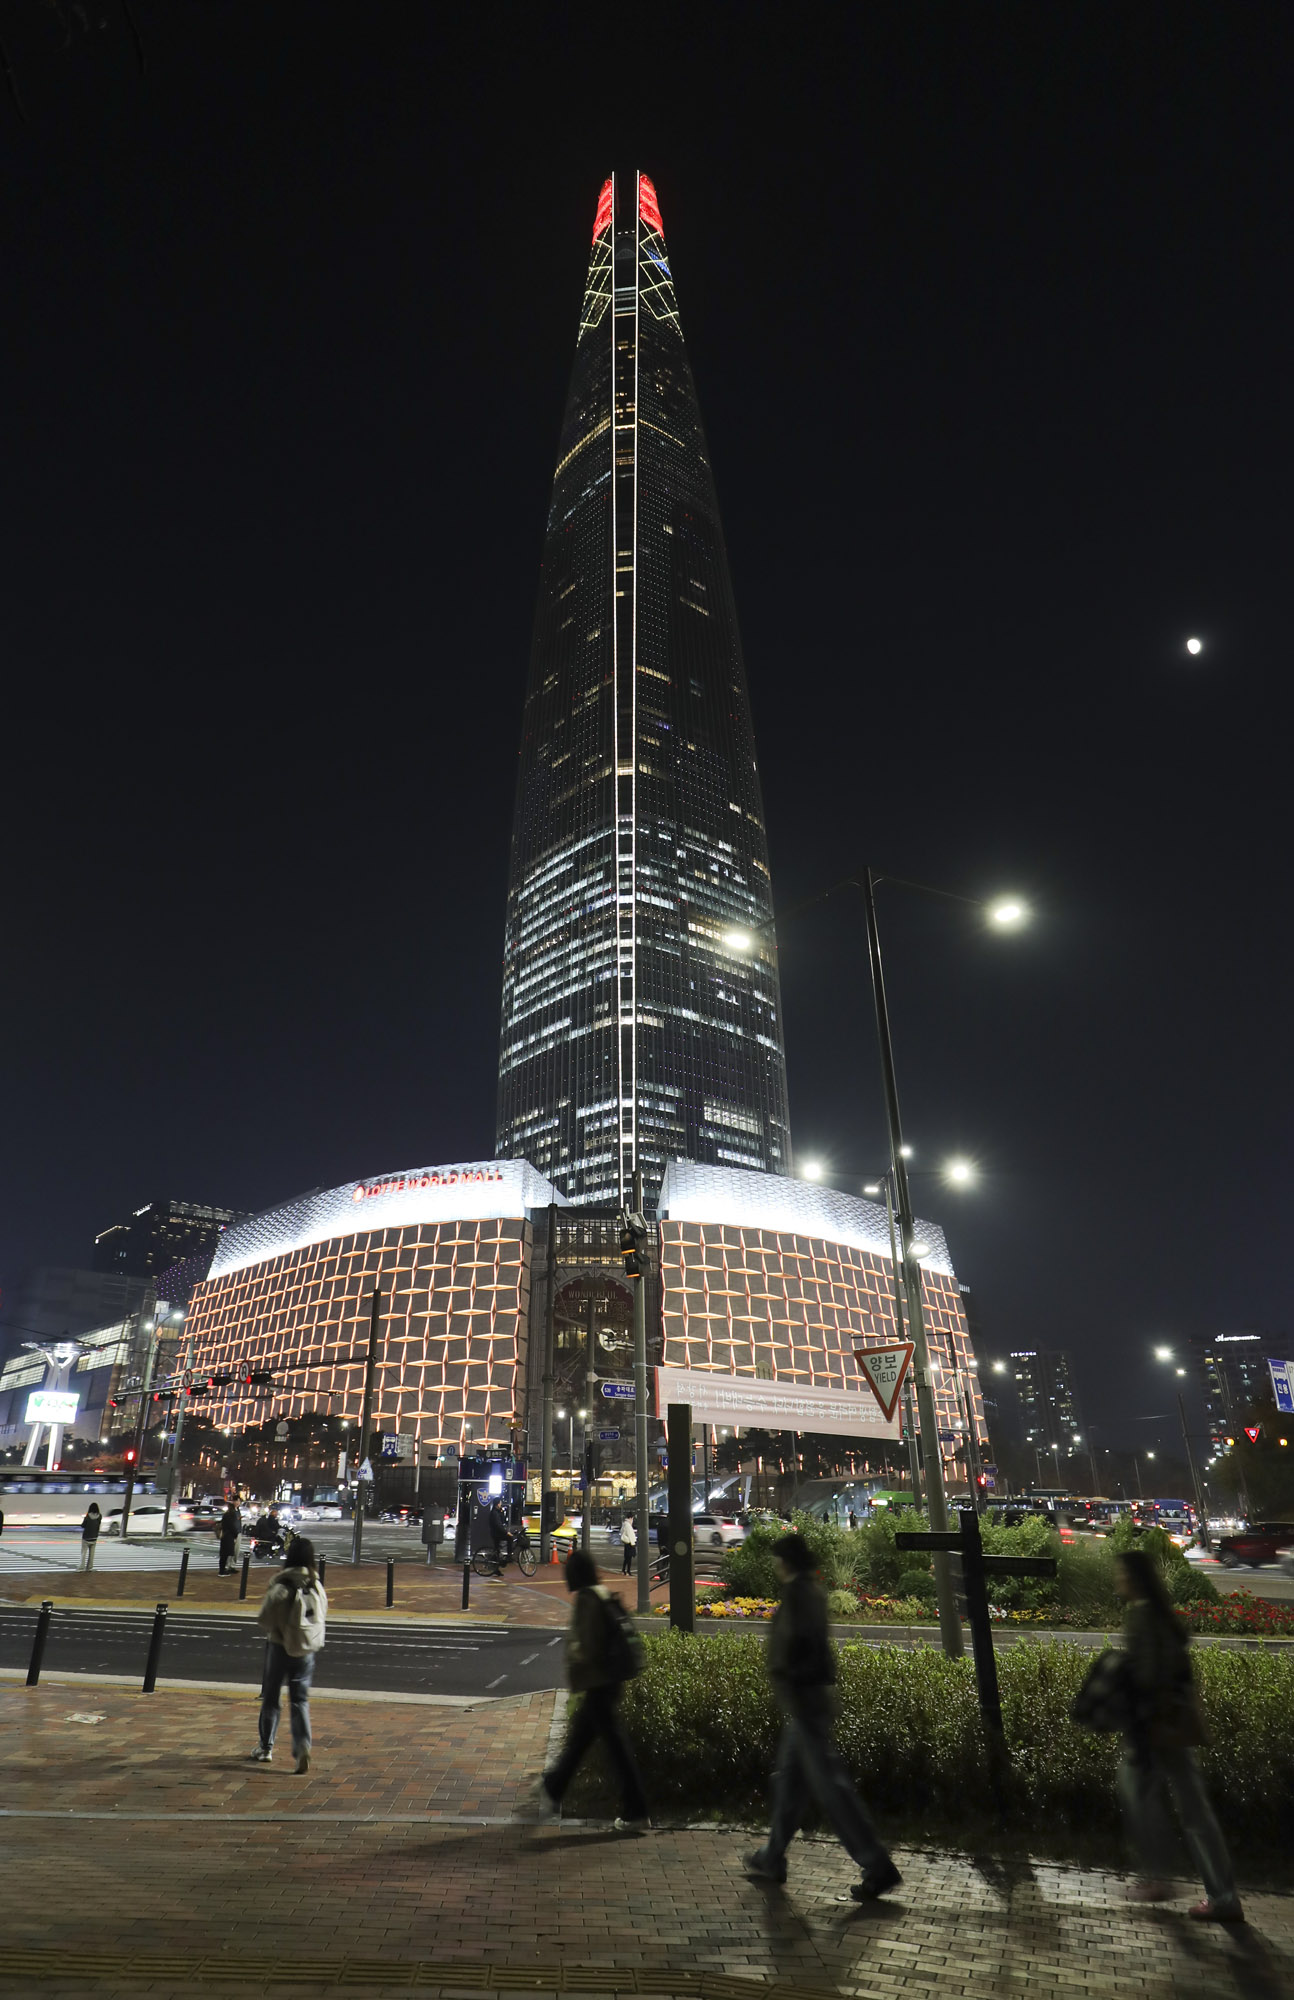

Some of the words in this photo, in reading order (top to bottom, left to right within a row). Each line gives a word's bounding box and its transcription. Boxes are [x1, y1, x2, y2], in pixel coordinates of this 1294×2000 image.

[365, 1181, 405, 1198] LOTTE
[407, 1174, 458, 1189] WORLD
[460, 1169, 501, 1184] MALL
[870, 1354, 897, 1371] 양보
[874, 1371, 897, 1383] YIELD
